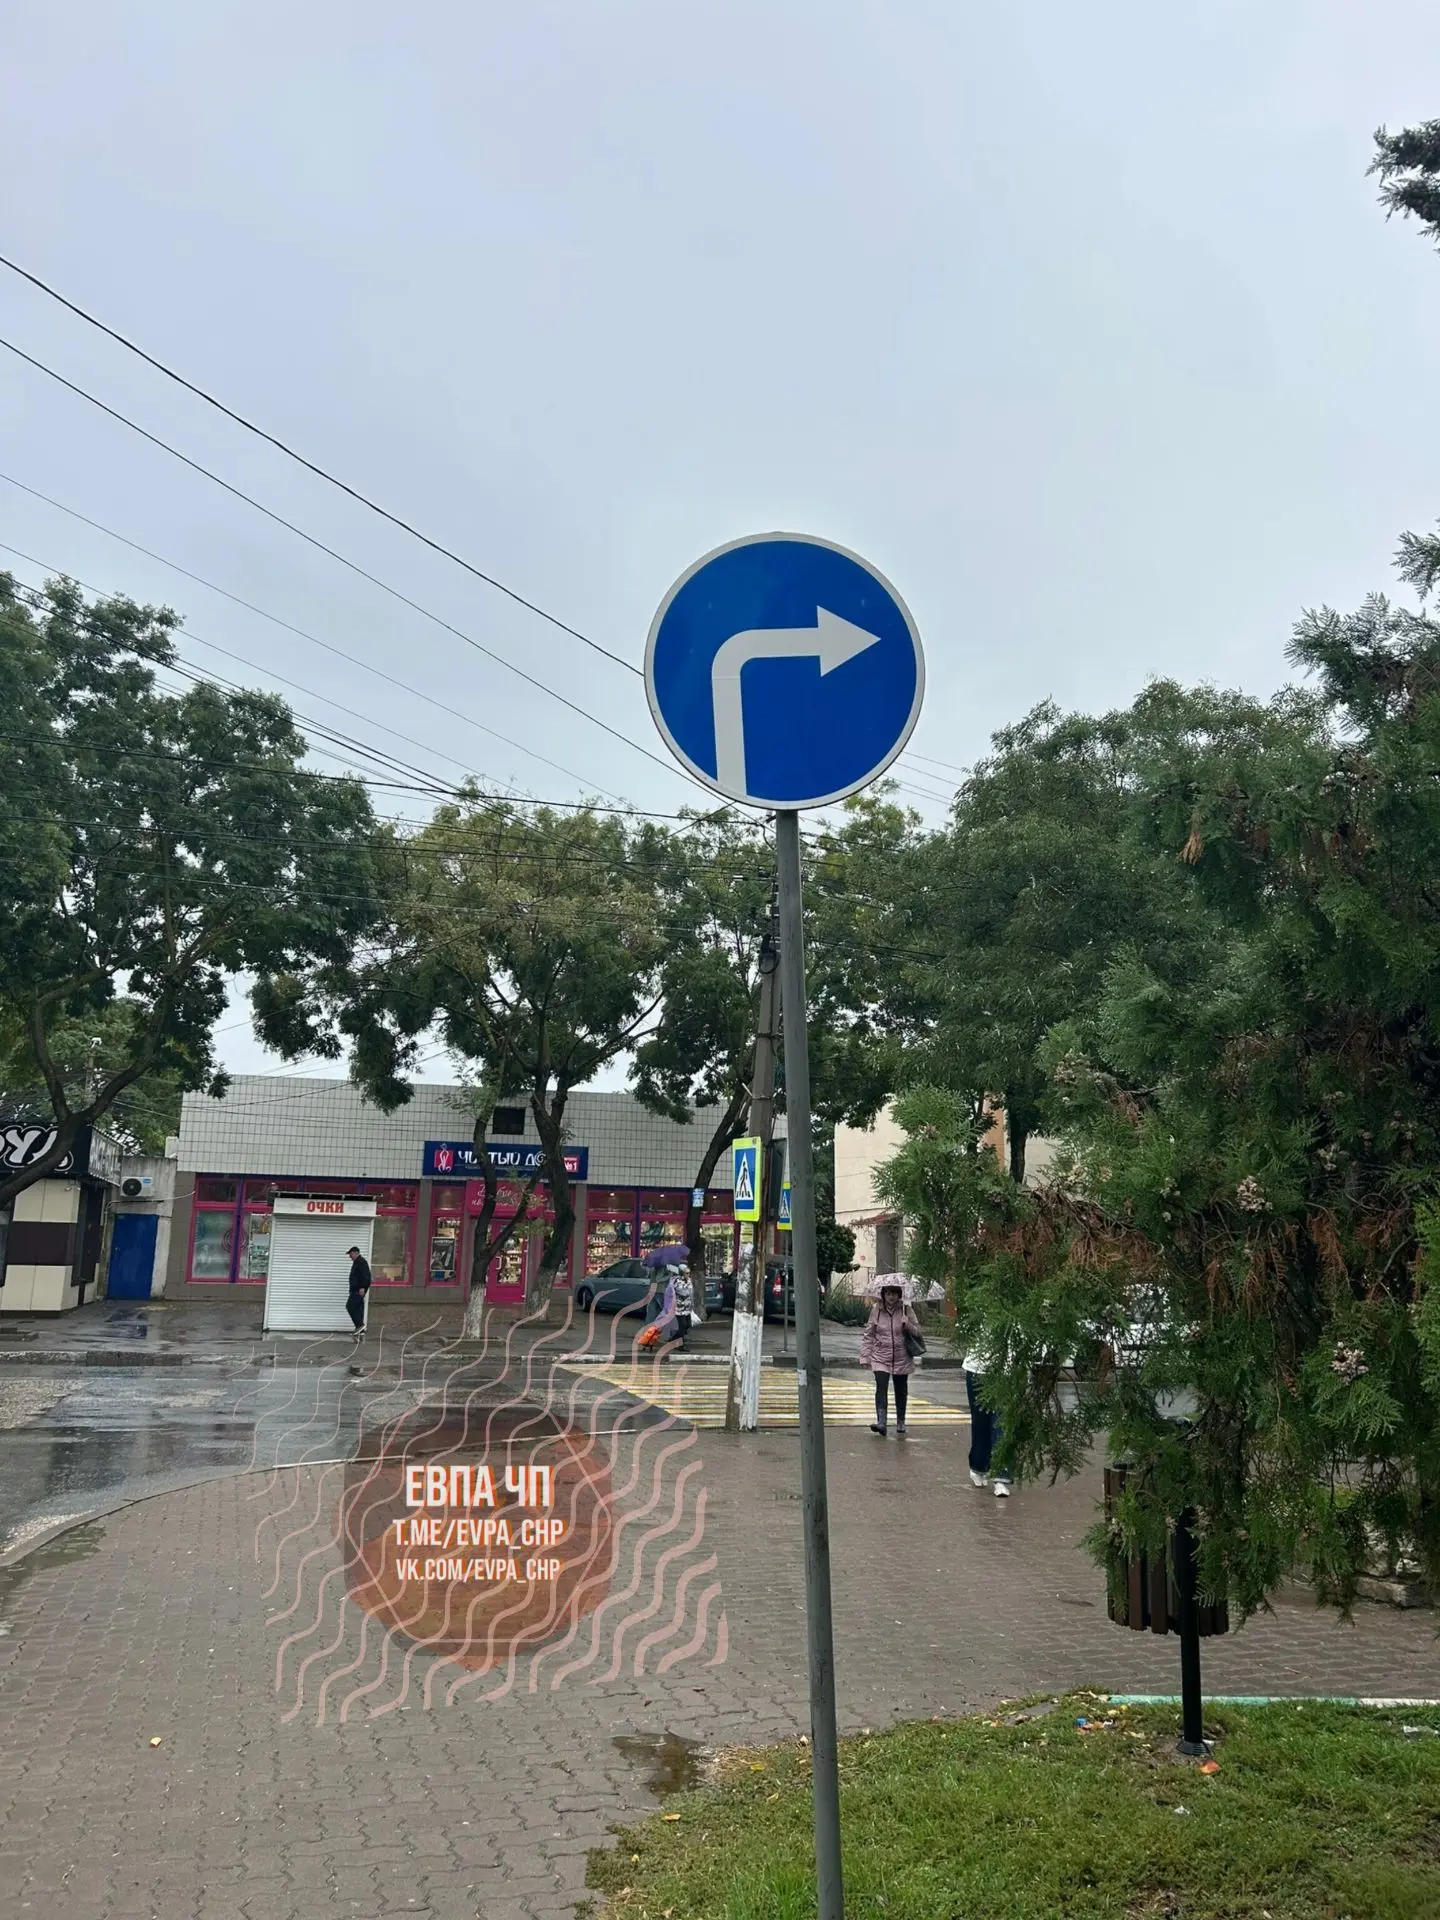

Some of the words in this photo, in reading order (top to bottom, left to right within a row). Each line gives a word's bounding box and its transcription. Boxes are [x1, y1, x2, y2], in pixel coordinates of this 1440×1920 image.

[458, 1150, 521, 1166] ЧИТЫЙ
[524, 1151, 546, 1167] ДО
[307, 1201, 344, 1213] ОЧКИ
